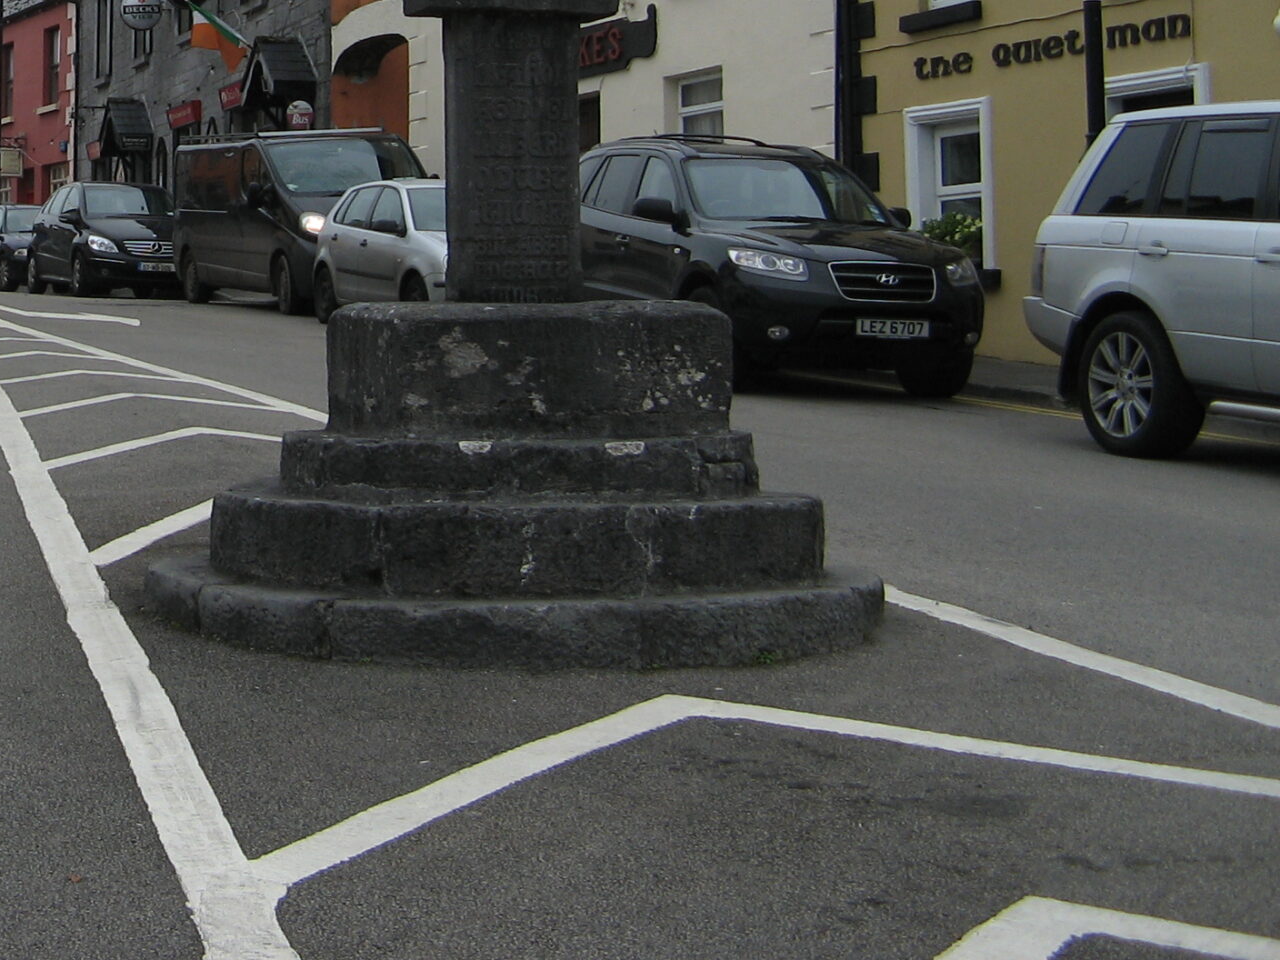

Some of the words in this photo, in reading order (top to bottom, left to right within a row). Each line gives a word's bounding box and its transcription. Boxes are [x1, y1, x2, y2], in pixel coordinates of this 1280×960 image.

[913, 51, 973, 80] the
[1106, 13, 1191, 49] man
[861, 320, 886, 334] LEZ
[890, 321, 924, 335] 6707
